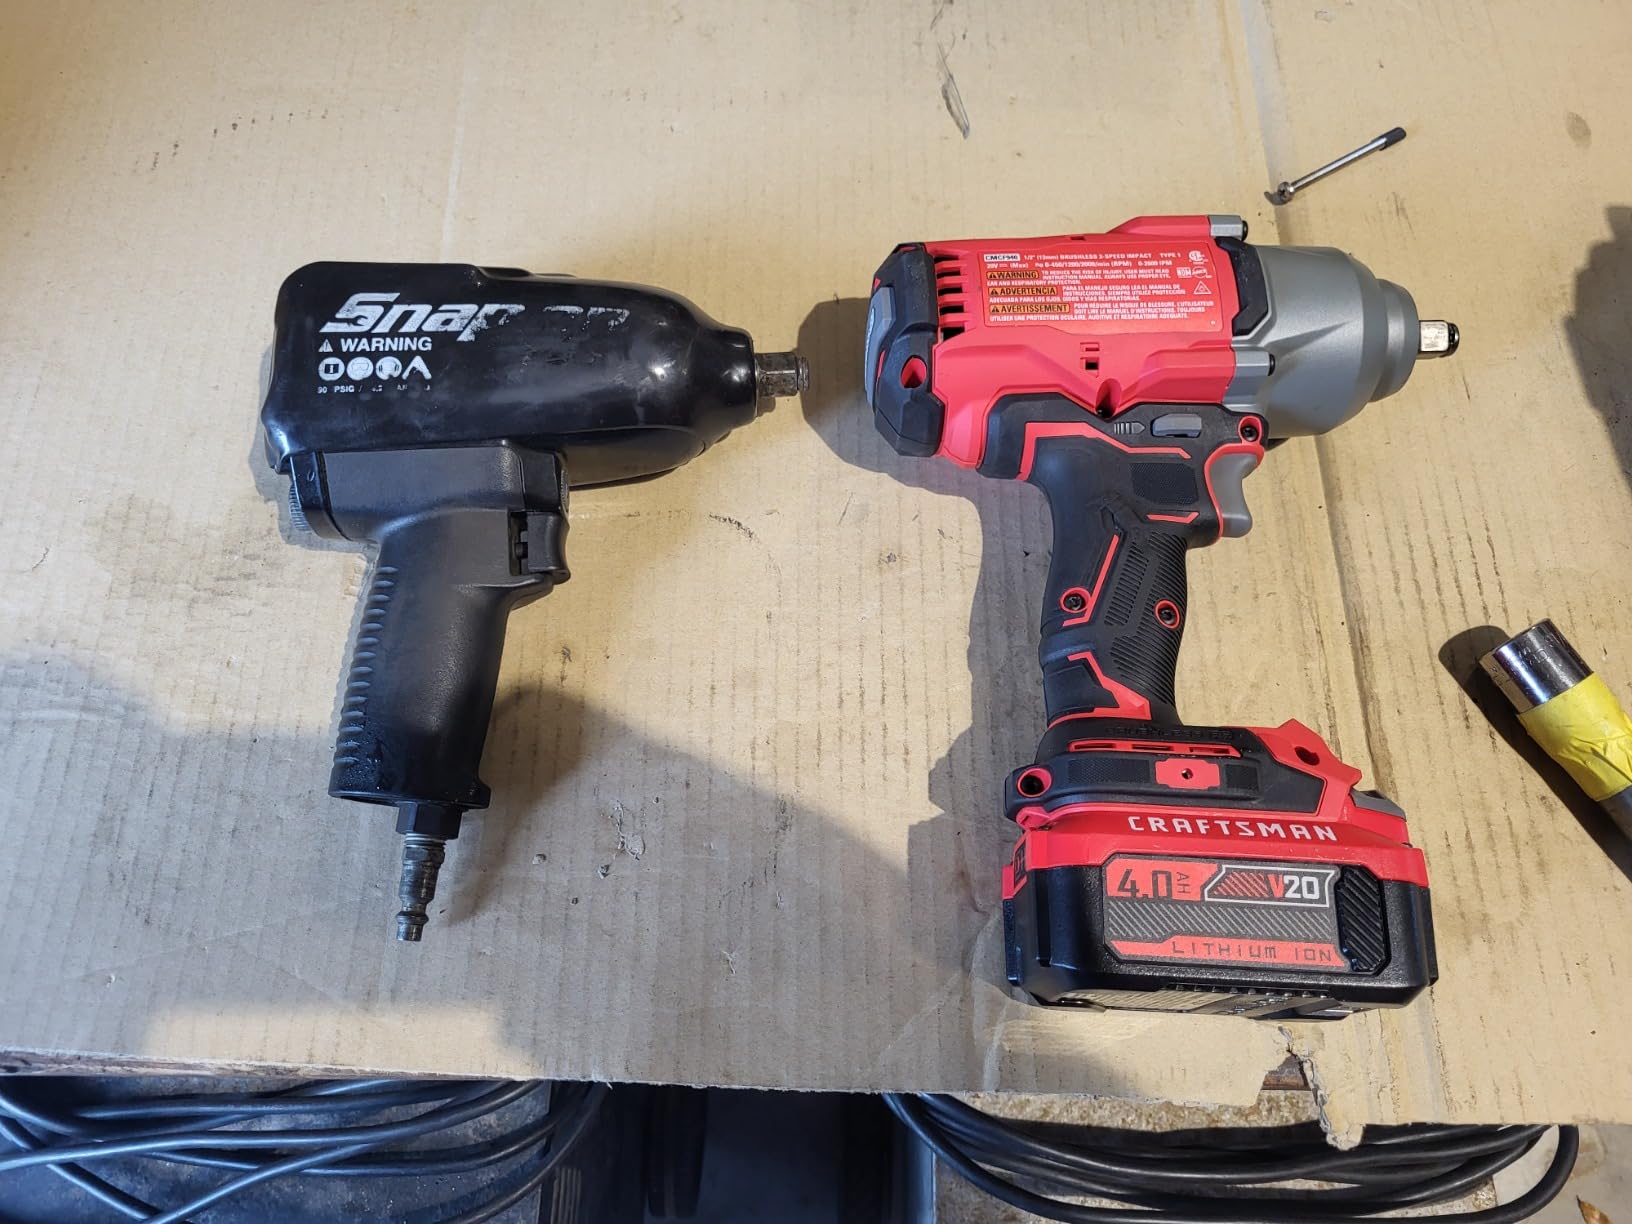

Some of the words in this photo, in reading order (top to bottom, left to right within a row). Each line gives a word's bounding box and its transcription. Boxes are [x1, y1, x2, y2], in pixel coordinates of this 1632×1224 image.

[340, 337, 432, 352] WARNING
[1128, 816, 1338, 842] CRAFTSMAN
[1117, 868, 1172, 900] 4.0
[1176, 871, 1190, 894] AH
[1267, 874, 1320, 899] V20
